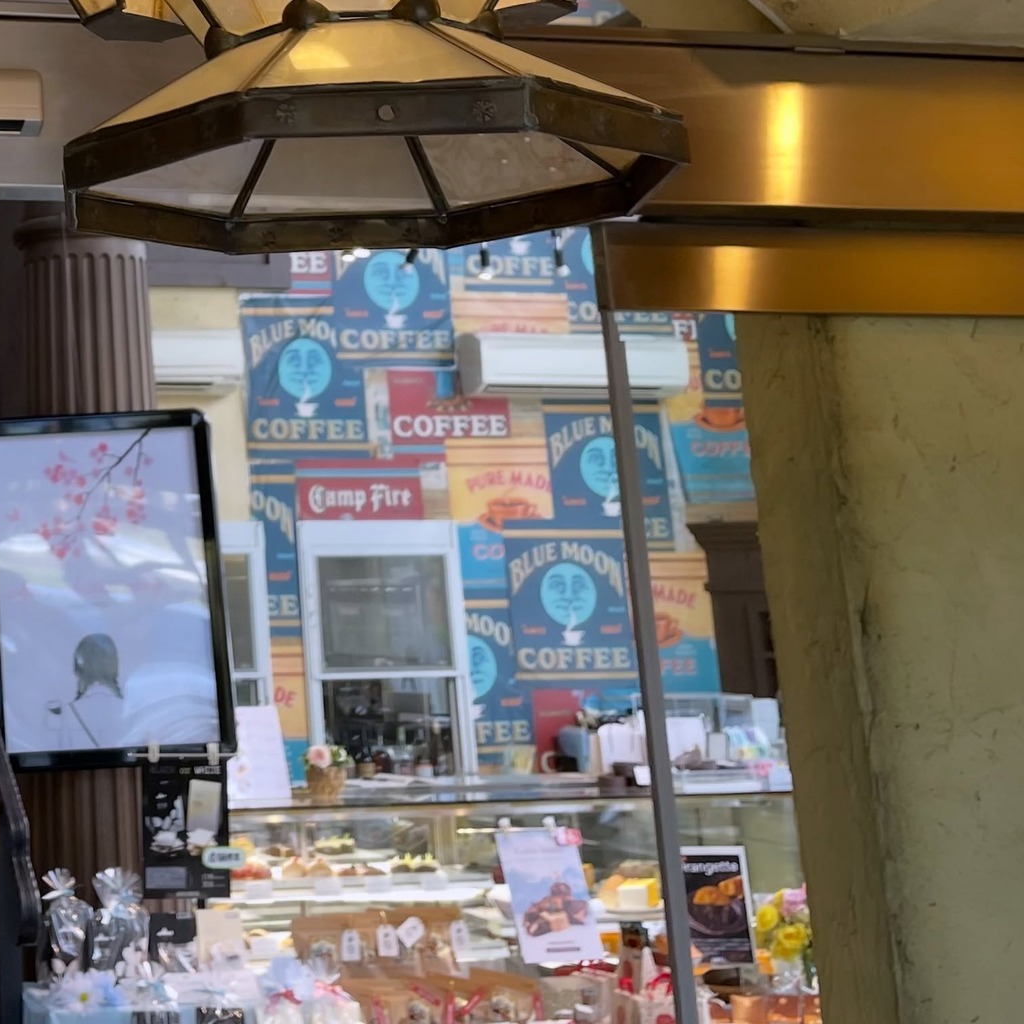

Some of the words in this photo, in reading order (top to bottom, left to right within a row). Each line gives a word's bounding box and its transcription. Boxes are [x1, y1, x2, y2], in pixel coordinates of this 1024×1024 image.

[466, 254, 554, 276] COFFE
[250, 319, 295, 368] BLUE
[339, 328, 451, 350] COFFEE
[252, 417, 365, 440] COFFEE
[393, 415, 507, 438] COFFEE
[549, 416, 595, 468] BLUE
[308, 484, 366, 513] Camp
[370, 484, 412, 512] Fire
[508, 542, 557, 597] BLUE
[560, 540, 624, 598] MOON
[517, 647, 631, 669] COFFEE
